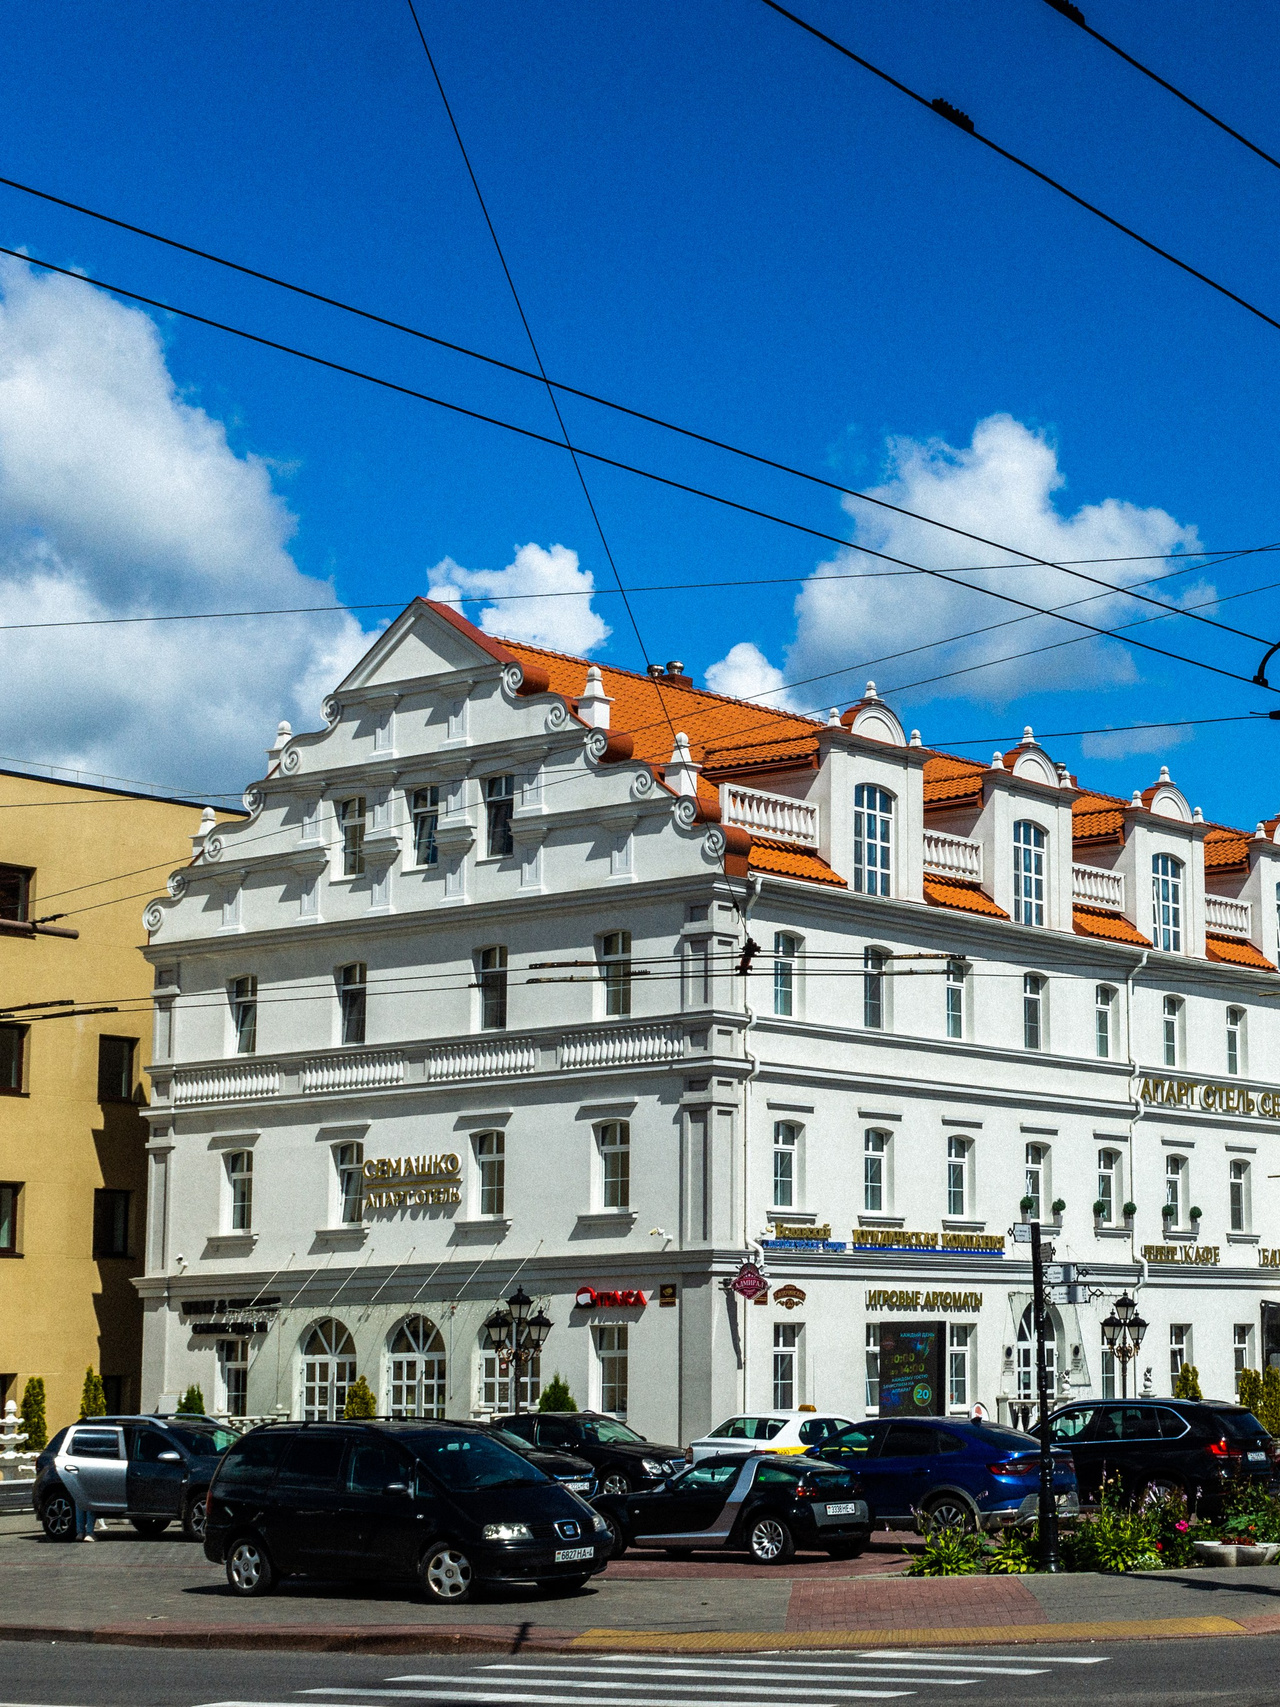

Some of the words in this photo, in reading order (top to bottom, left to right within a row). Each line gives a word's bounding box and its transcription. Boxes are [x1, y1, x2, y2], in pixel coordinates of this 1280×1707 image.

[1140, 1078, 1198, 1105] АПАРТ
[1203, 1085, 1255, 1112] ОТЕЛЬ
[362, 1153, 460, 1179] СЕМАШКО
[852, 1229, 939, 1246] ЮРИДИЧЕСКАЯ
[941, 1233, 1006, 1249] КОМПАНИЯ
[1183, 1245, 1221, 1264] КАФЕ
[735, 1279, 764, 1289] АДМИРАЛ
[867, 1289, 921, 1307] ИГРОВЫЕ
[923, 1291, 983, 1307] АВТОМАТЫ
[916, 1389, 930, 1400] 20
[561, 1550, 576, 1561] 6827
